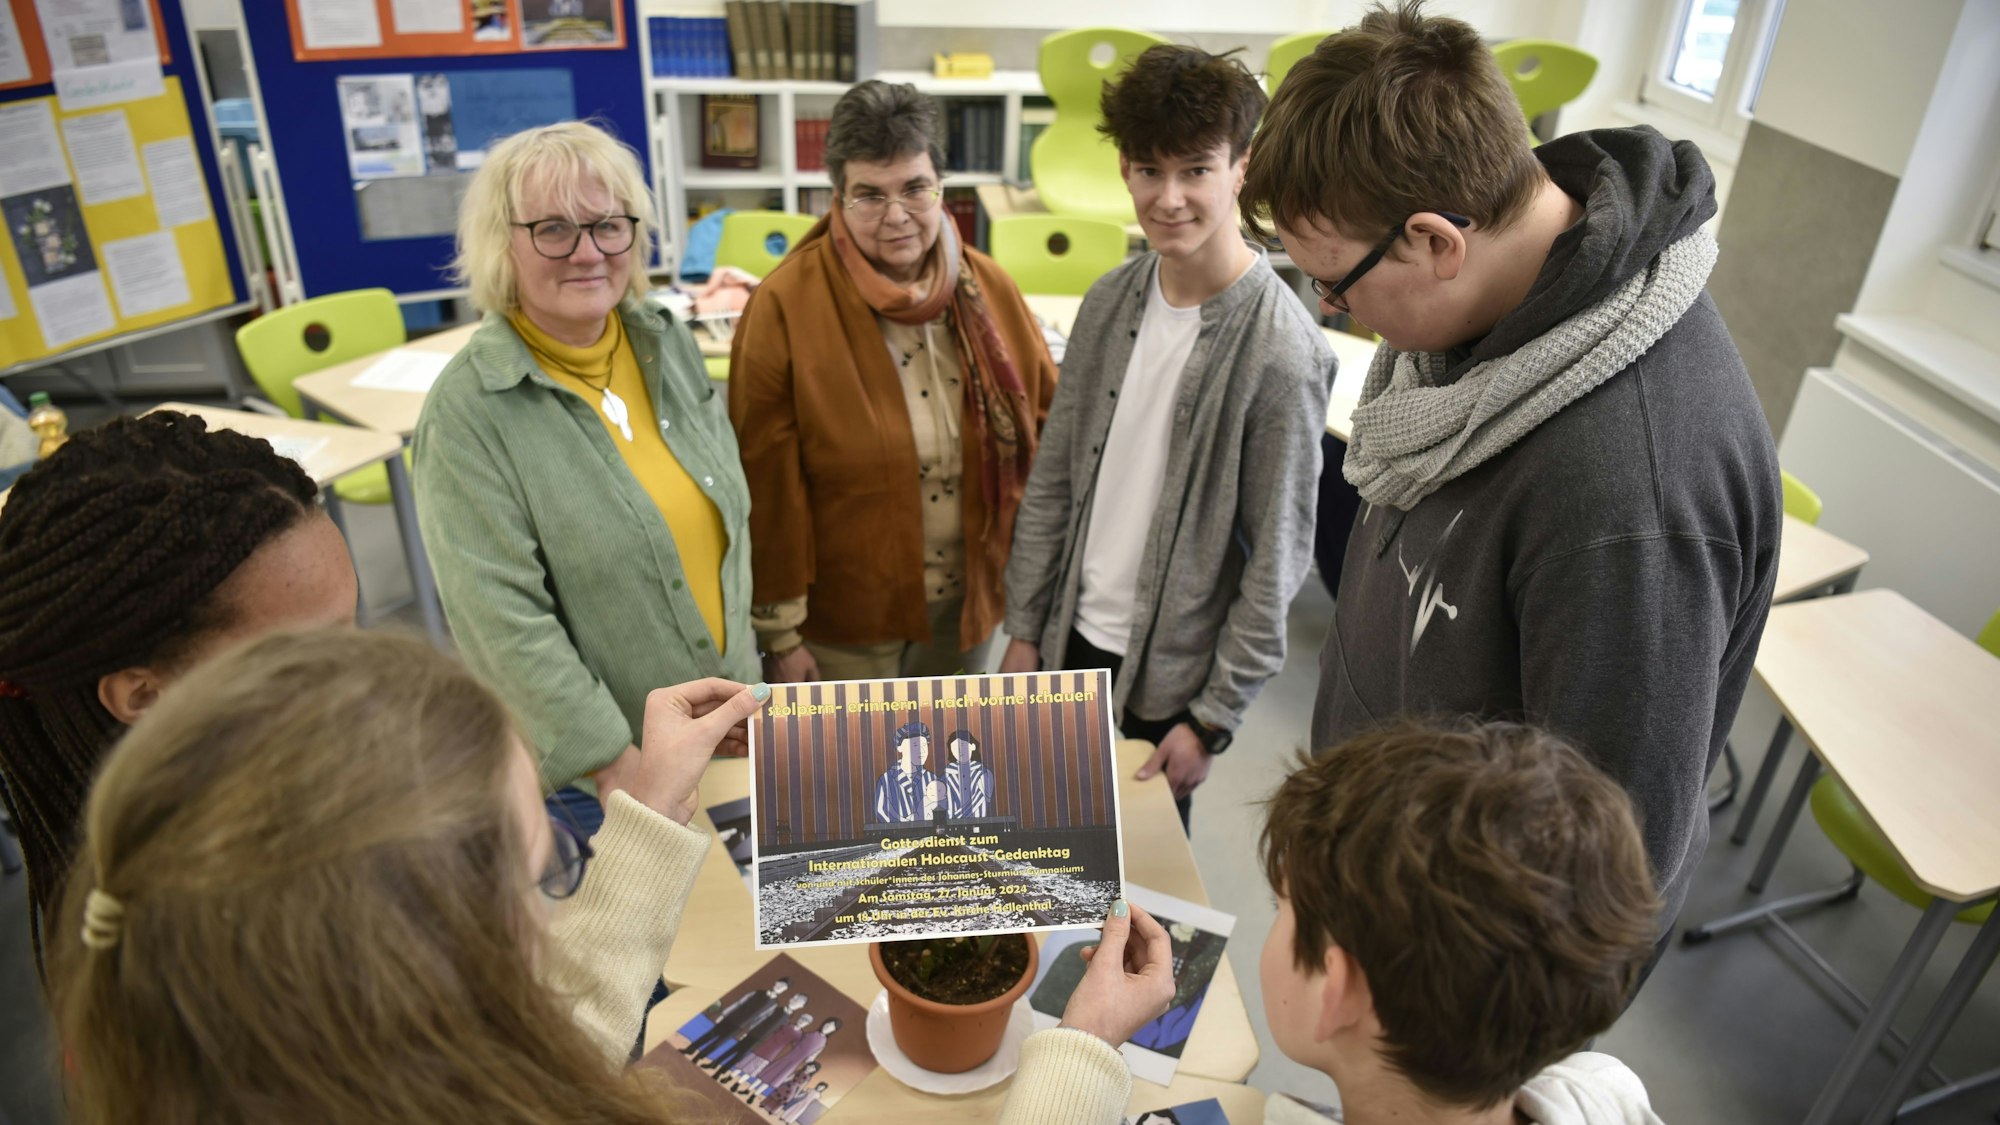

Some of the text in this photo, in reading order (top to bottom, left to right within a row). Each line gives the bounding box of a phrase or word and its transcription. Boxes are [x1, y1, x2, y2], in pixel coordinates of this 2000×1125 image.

[767, 701, 843, 718] stolpern-
[848, 699, 917, 714] erinnern
[934, 694, 974, 709] nach
[978, 694, 1024, 707] vorne
[1029, 690, 1094, 704] schauen
[880, 835, 999, 850] Gottesdienst zum
[808, 847, 1070, 872] Internationalen Holocaust-Gedenktag
[796, 881, 814, 889] von
[816, 880, 835, 888] und
[837, 879, 853, 887] mit
[921, 873, 936, 882] des
[858, 884, 1028, 904] Am Samstag, 27. Januar 2024
[835, 914, 855, 924] um
[857, 911, 869, 922] 18
[871, 910, 893, 921] Uhr
[897, 910, 909, 919] in
[911, 908, 930, 918] der
[953, 904, 990, 917] Kirche
[993, 900, 1052, 915] Hellenthal
